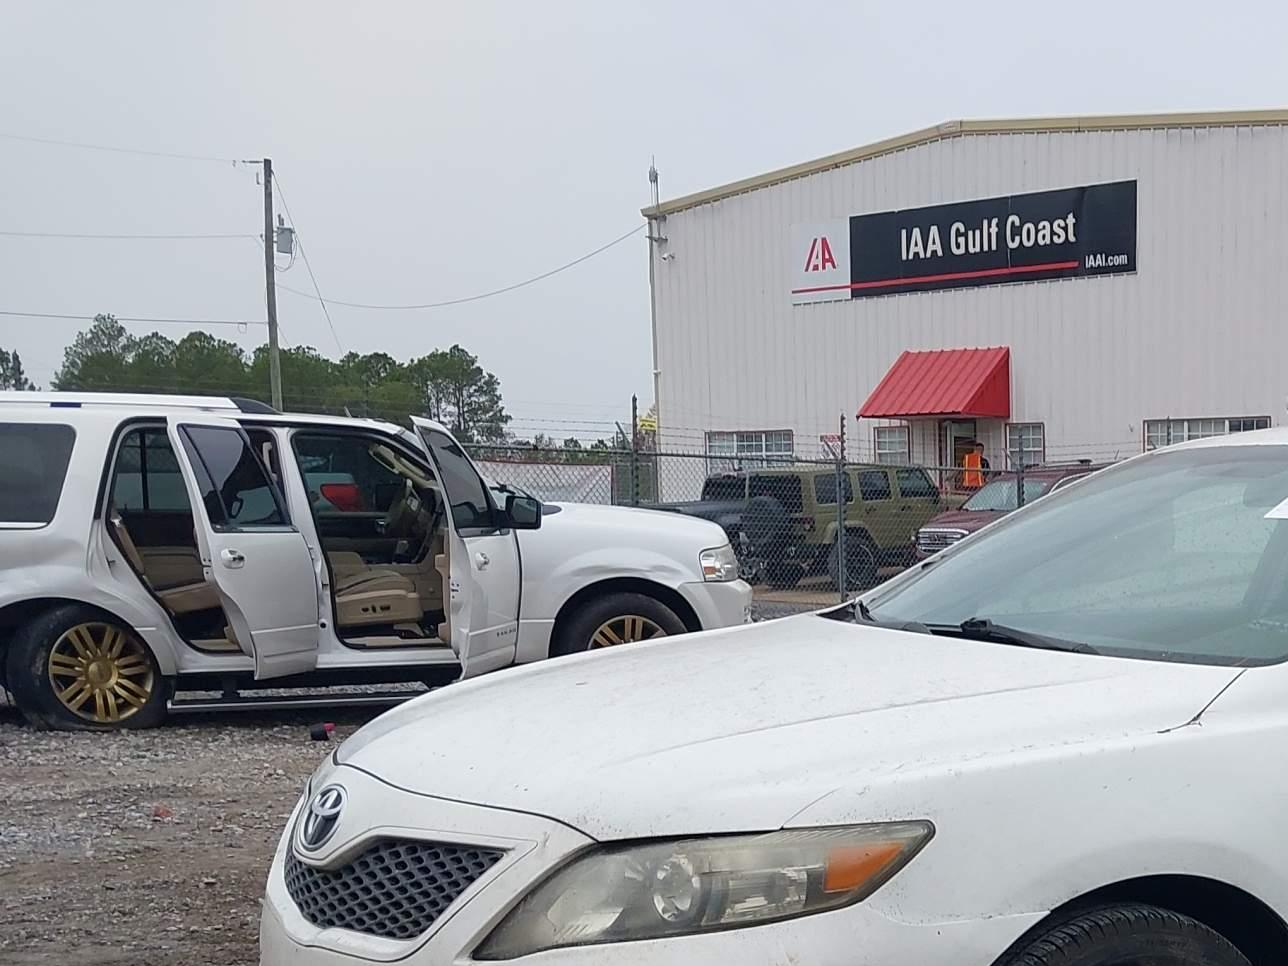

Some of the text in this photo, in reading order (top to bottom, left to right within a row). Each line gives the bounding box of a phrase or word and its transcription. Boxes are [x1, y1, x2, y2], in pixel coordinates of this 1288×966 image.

[901, 212, 1077, 260] IAA Gulf Coast
[1085, 253, 1128, 269] IAAI.com
